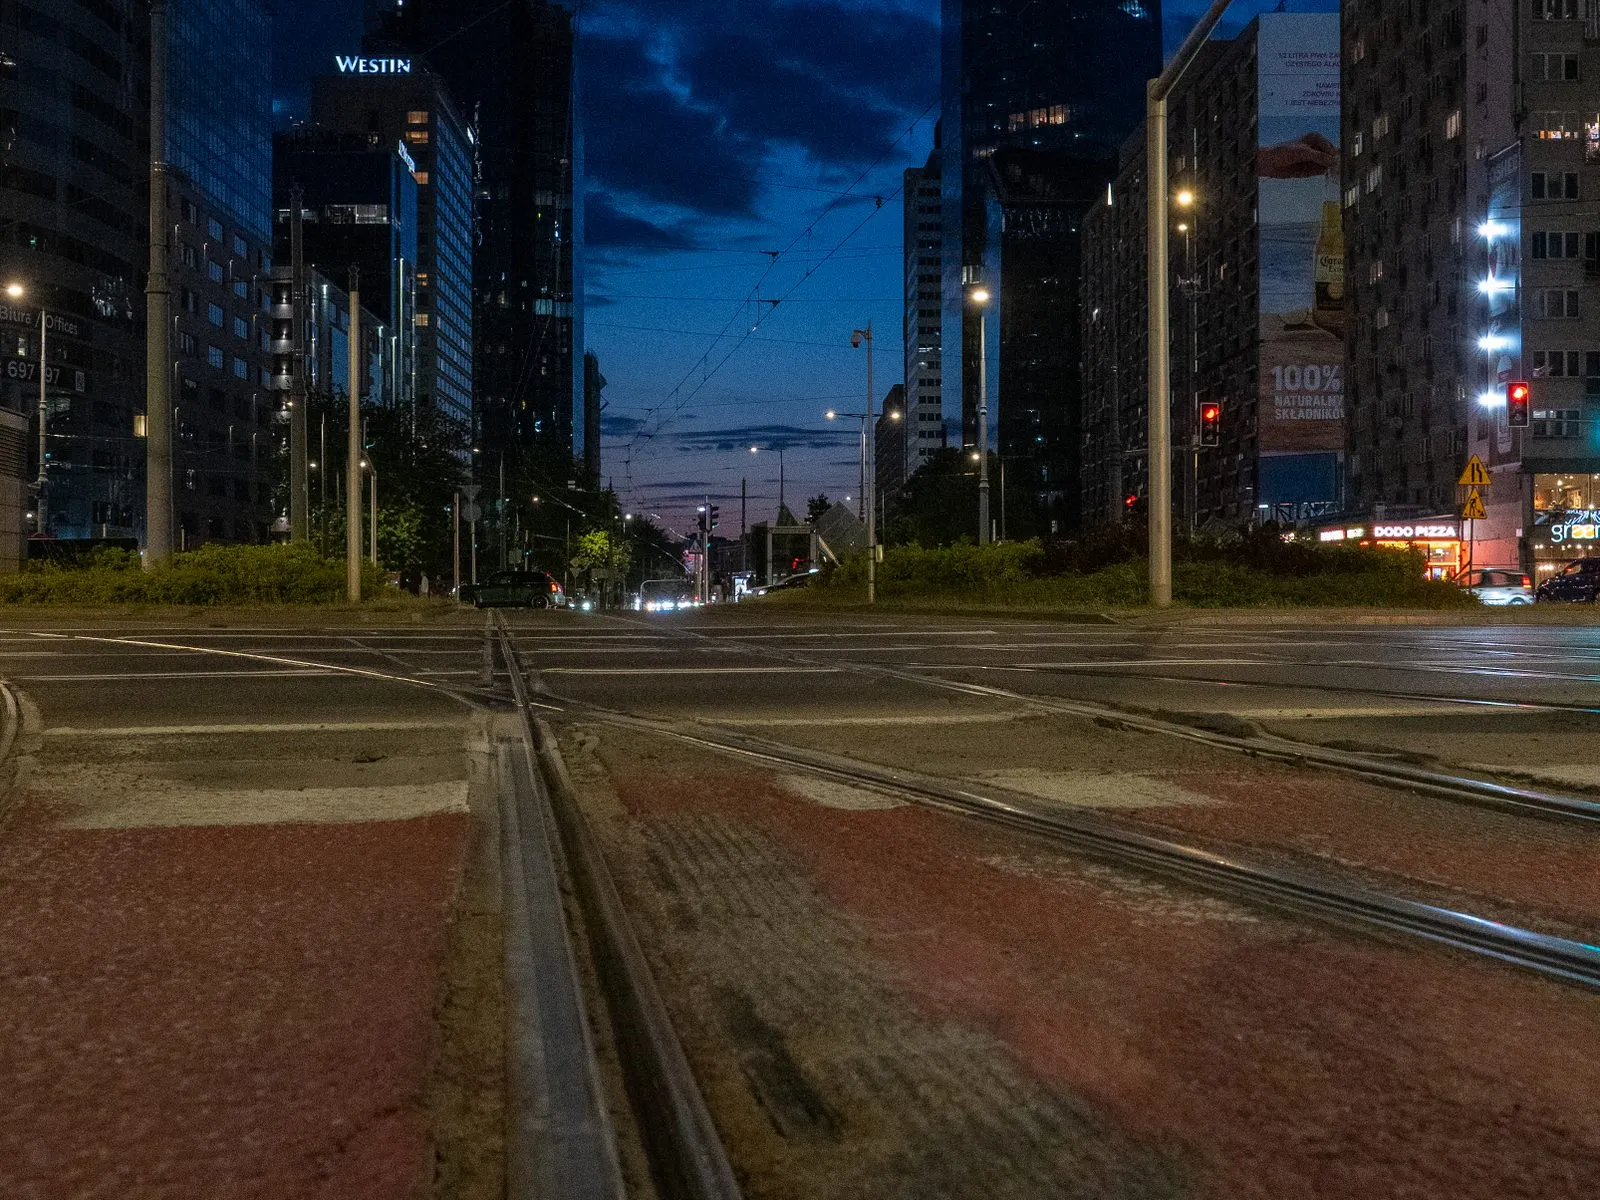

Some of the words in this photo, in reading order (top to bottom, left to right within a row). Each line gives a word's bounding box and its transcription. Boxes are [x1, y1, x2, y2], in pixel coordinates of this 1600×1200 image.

[335, 55, 411, 73] WESTIN
[1320, 254, 1344, 267] Coro
[0, 306, 32, 325] Biura
[7, 360, 36, 380] 697
[44, 366, 60, 385] 97
[1272, 365, 1344, 391] 100%
[1374, 526, 1413, 537] DODO
[1415, 526, 1455, 537] PIZZA
